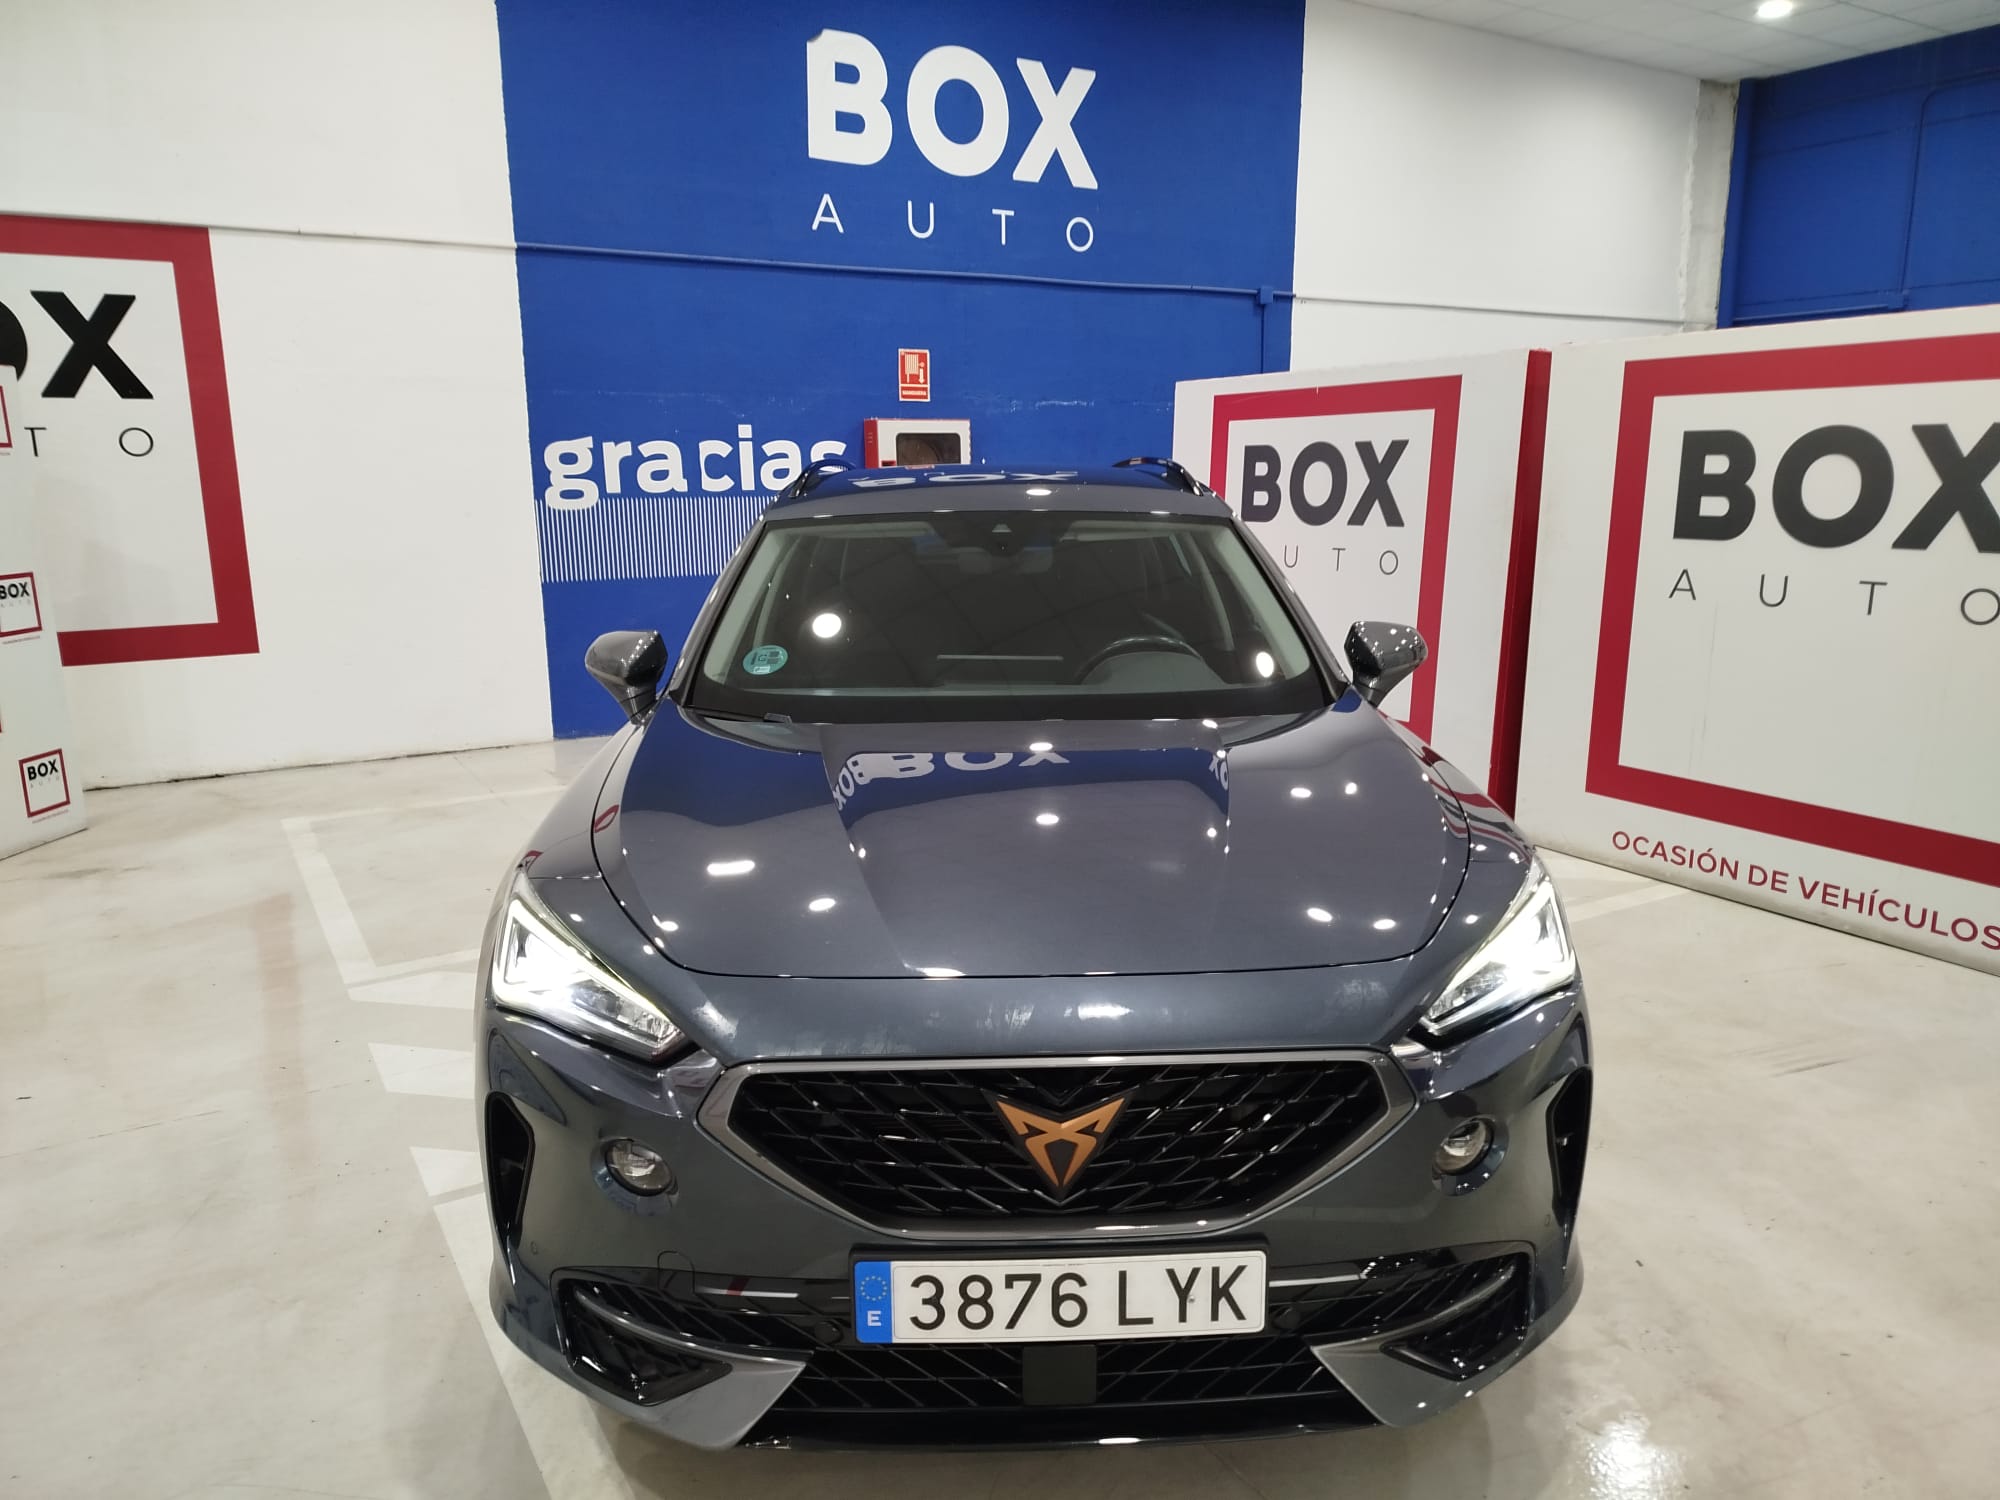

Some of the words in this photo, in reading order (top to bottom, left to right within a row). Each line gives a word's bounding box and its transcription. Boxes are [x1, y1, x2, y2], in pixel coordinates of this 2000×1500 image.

[806, 28, 1098, 190] BOX
[811, 193, 1094, 253] AUTO
[1241, 439, 1410, 528] BOX
[1673, 421, 2000, 554] BOX
[1283, 545, 1399, 575] UTO
[0, 582, 30, 600] BOX
[1669, 568, 2000, 625] AUTO
[27, 758, 59, 781] BOX
[1611, 830, 1740, 881] OCASIÓN
[1747, 864, 1790, 894] DE
[1797, 876, 2000, 951] VEHÍCULOS
[866, 1310, 882, 1327] E
[909, 1271, 1088, 1331] 3876
[1117, 1264, 1249, 1326] LYK
